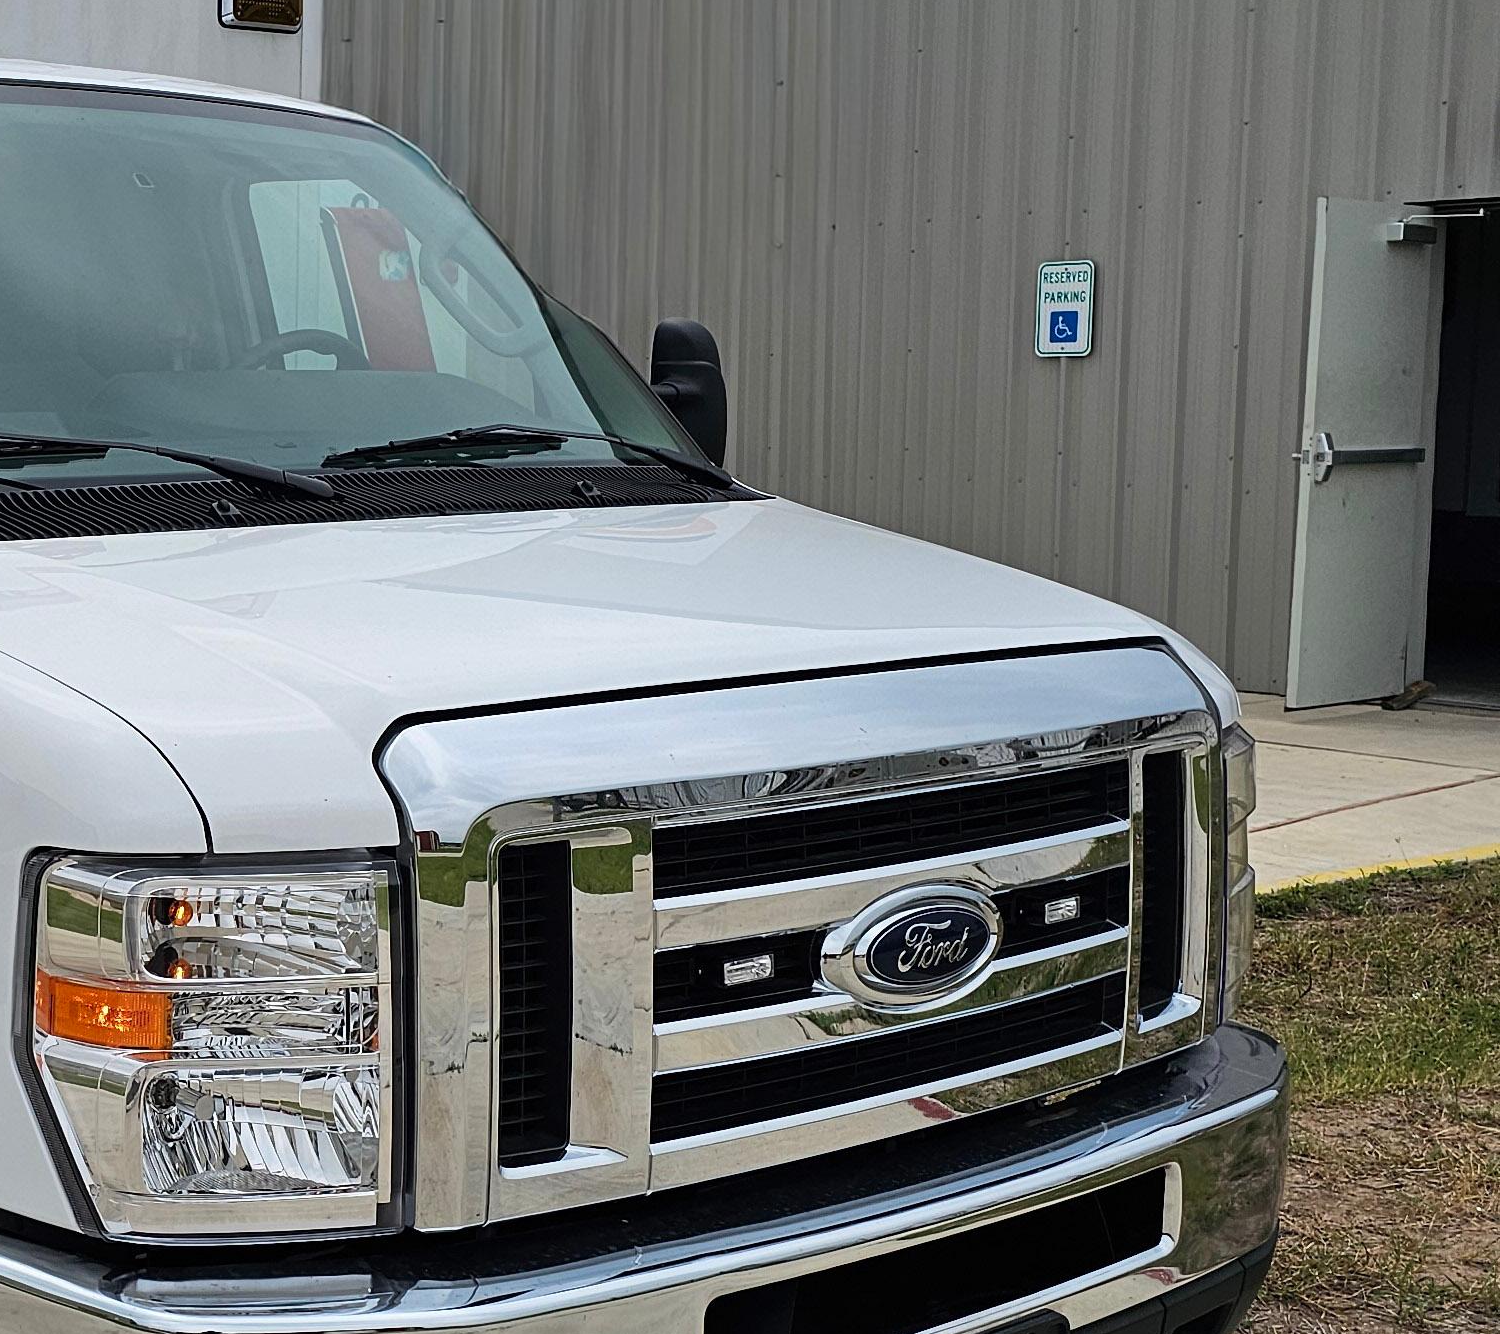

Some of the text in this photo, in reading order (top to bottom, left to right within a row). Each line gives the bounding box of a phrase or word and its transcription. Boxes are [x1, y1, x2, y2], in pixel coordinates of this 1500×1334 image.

[1043, 270, 1089, 284] RESERVED
[1043, 290, 1087, 304] PARKING
[897, 919, 970, 974] Ford
